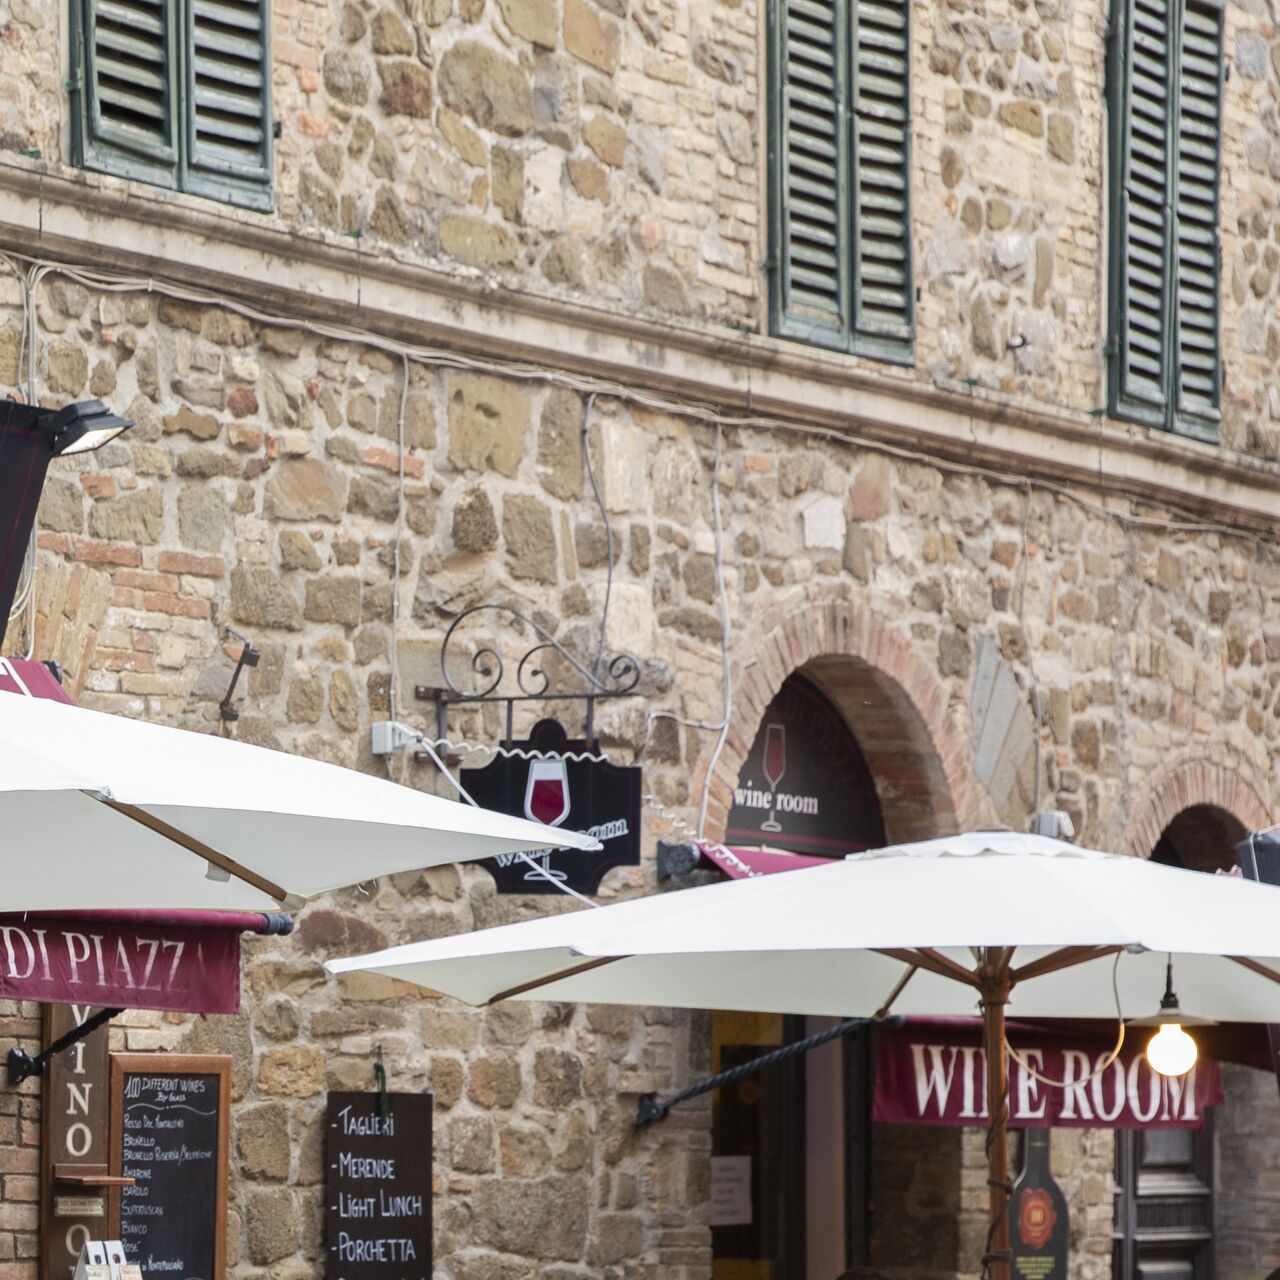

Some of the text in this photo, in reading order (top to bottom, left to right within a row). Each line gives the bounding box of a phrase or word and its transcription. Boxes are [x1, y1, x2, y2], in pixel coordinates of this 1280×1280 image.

[733, 780, 820, 817] wine room
[0, 926, 54, 981] DI
[124, 1076, 206, 1098] 100 DIFFERENT WINES
[911, 1044, 1201, 1122] WIE ROOM
[338, 1105, 394, 1137] TAGLIERI
[124, 1133, 156, 1147] BRUNELLO
[339, 1152, 395, 1179] MERENDE
[339, 1189, 422, 1218] LIGHT LUNCH
[121, 1221, 147, 1234] BIANCO
[339, 1232, 416, 1262] PORCHETTA
